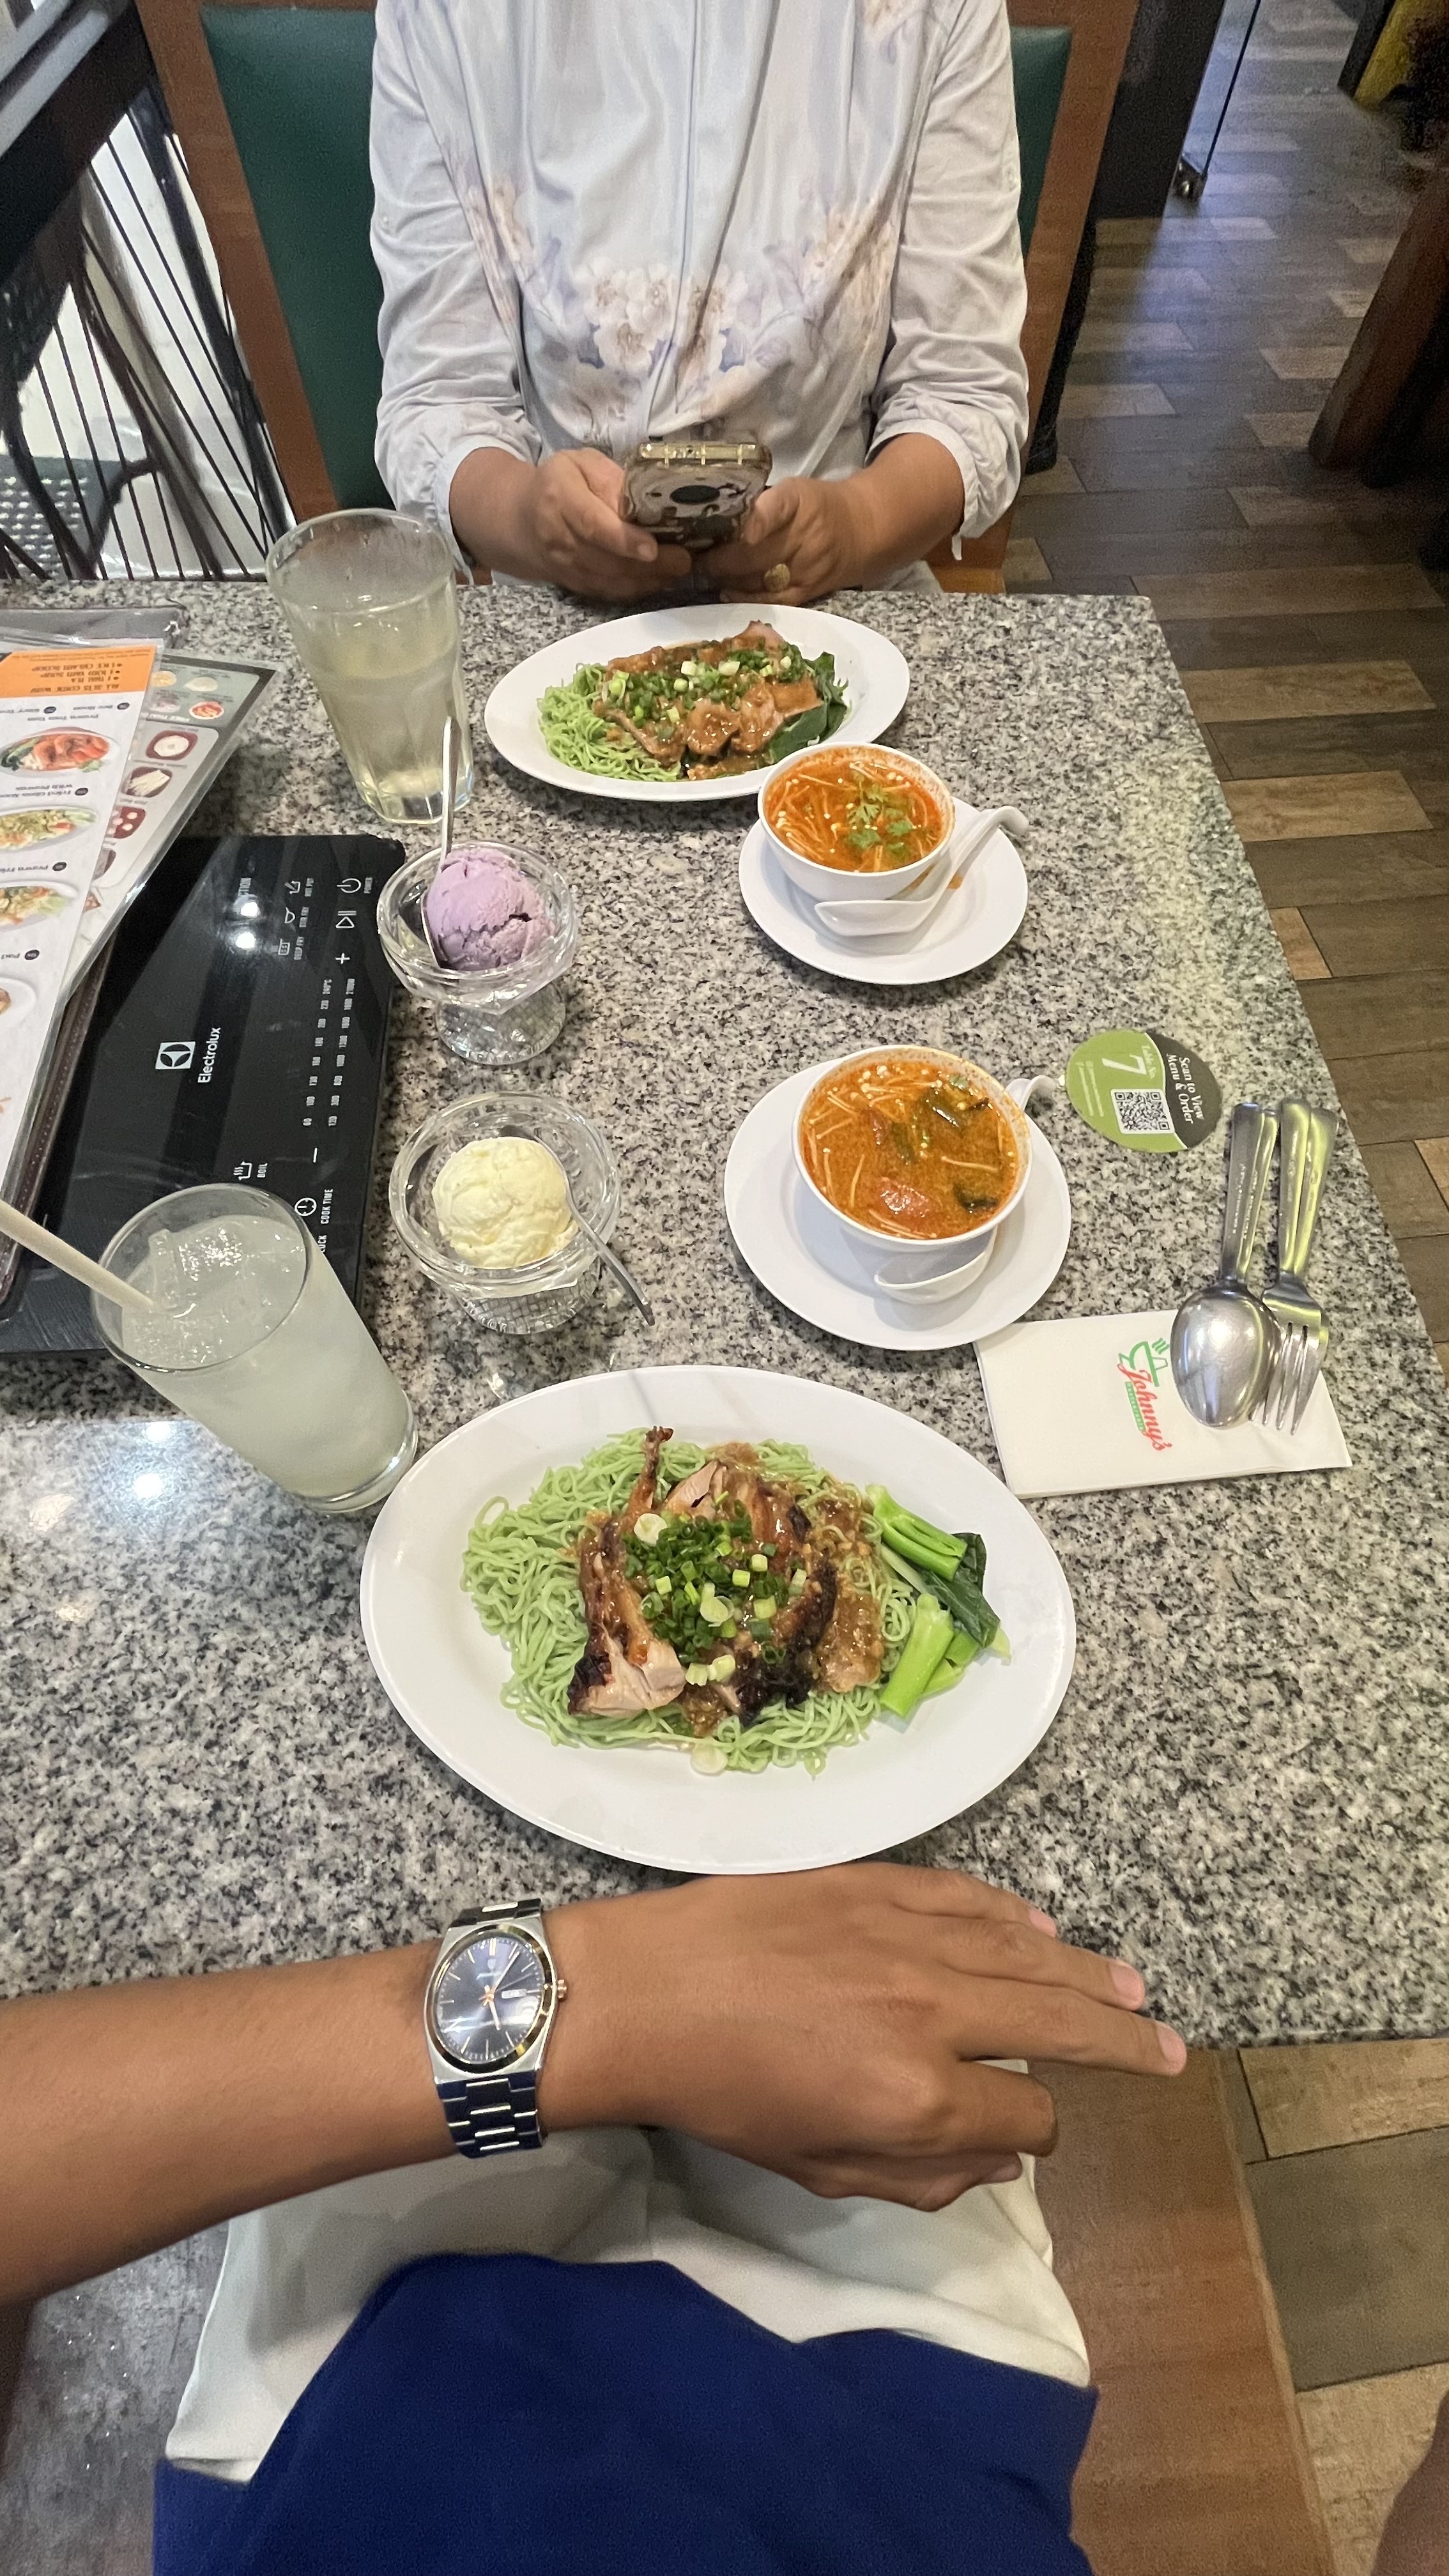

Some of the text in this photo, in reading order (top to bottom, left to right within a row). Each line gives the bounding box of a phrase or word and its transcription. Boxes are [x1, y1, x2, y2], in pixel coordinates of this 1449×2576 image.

[197, 1027, 221, 1083] Electrolux
[1101, 1054, 1147, 1076] 7
[1166, 1054, 1194, 1124] Menu & Order
[1179, 1057, 1205, 1121] Scan to View
[257, 1163, 268, 1178] BOIL
[320, 1188, 334, 1225] COOK TIME
